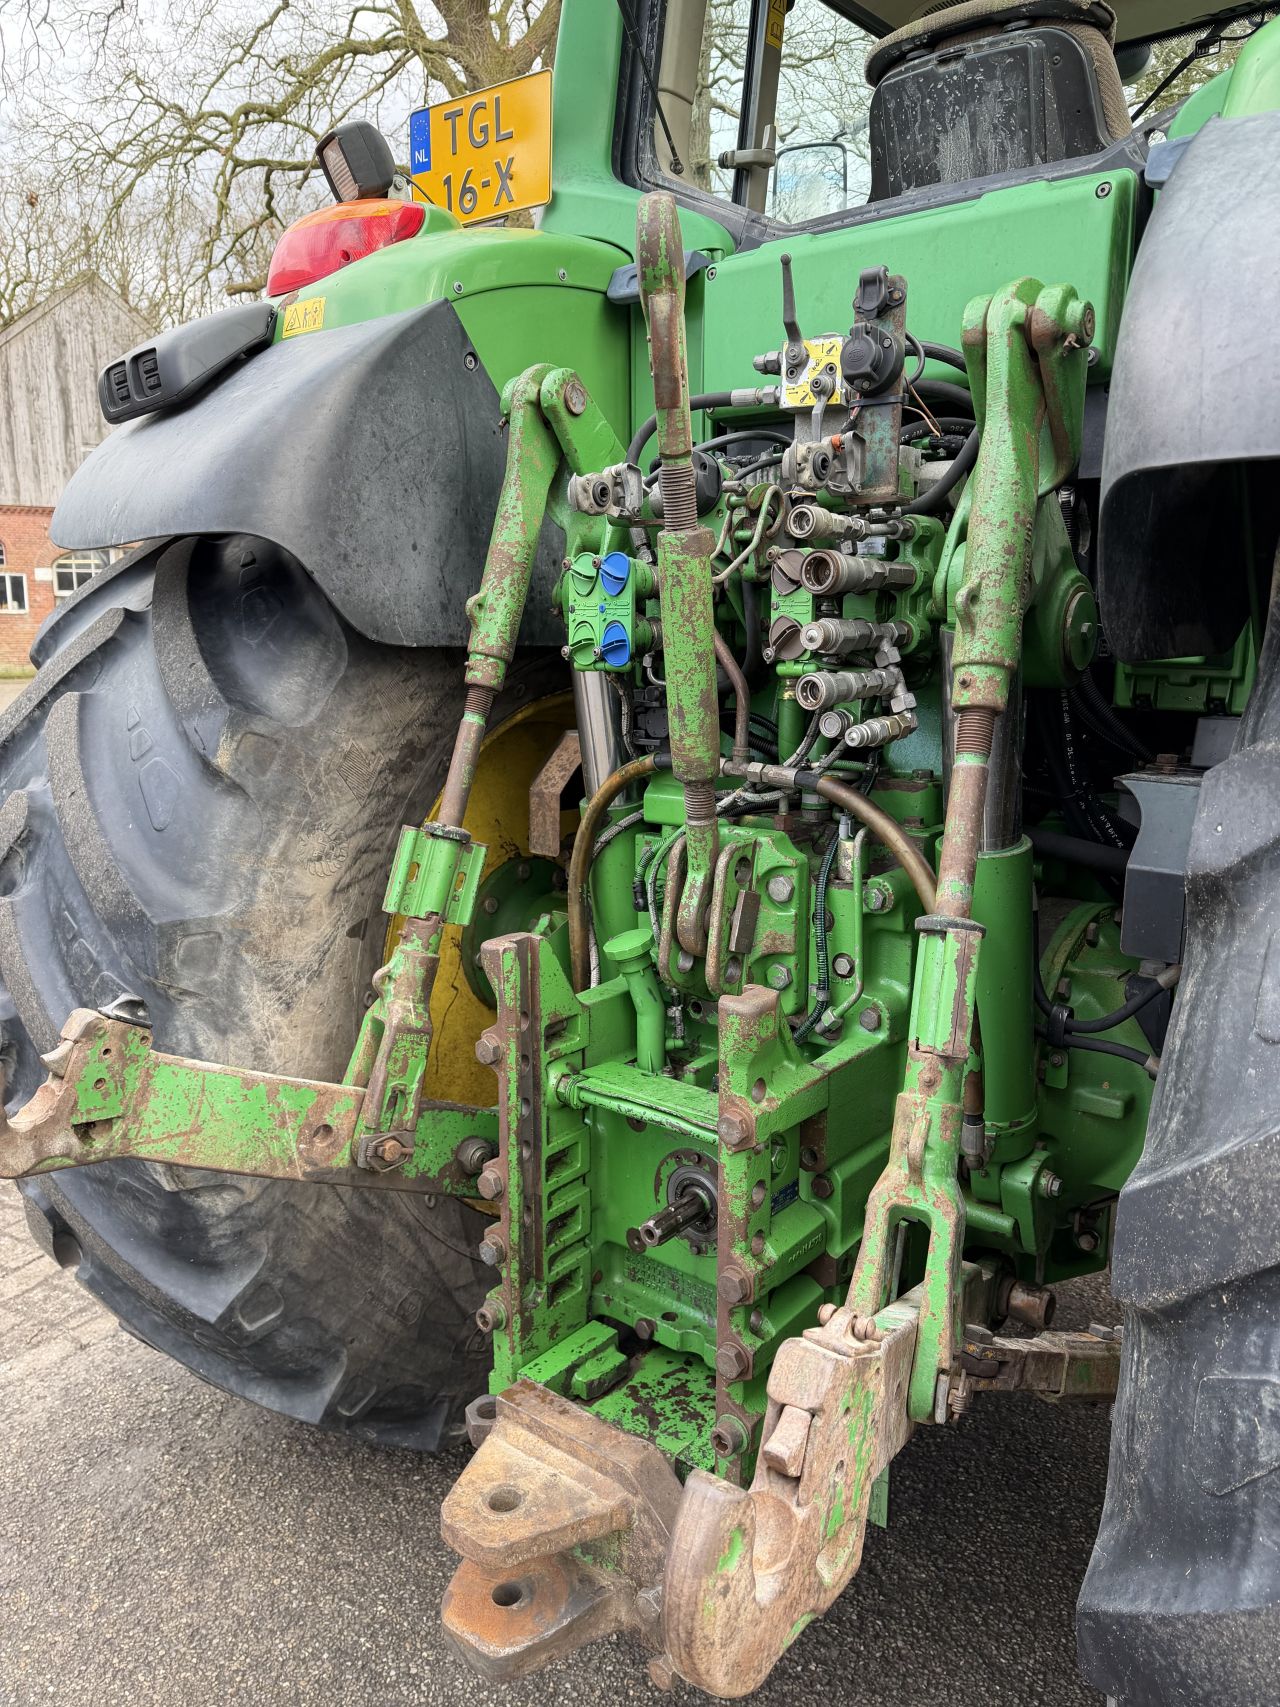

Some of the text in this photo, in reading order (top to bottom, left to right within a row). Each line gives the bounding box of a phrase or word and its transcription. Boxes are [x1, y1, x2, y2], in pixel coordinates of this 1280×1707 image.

[443, 95, 514, 156] TGL
[415, 148, 429, 164] NL
[442, 156, 515, 215] 16-X
